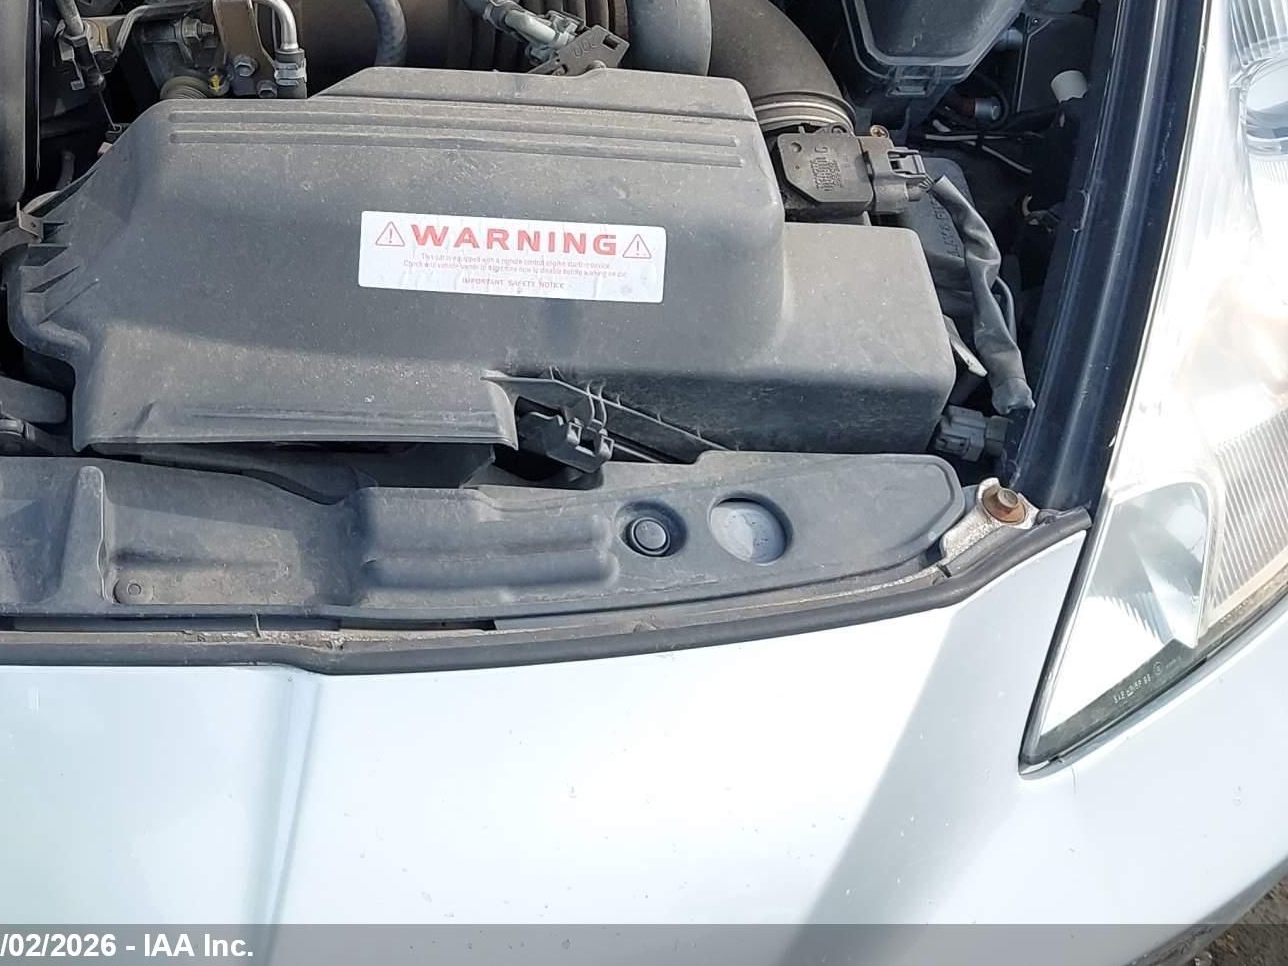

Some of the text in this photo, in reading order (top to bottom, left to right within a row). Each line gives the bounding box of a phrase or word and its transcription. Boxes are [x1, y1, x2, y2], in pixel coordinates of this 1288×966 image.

[411, 224, 617, 256] WARNING
[462, 277, 504, 286] IMPORTANT
[538, 280, 565, 289] NOTICE
